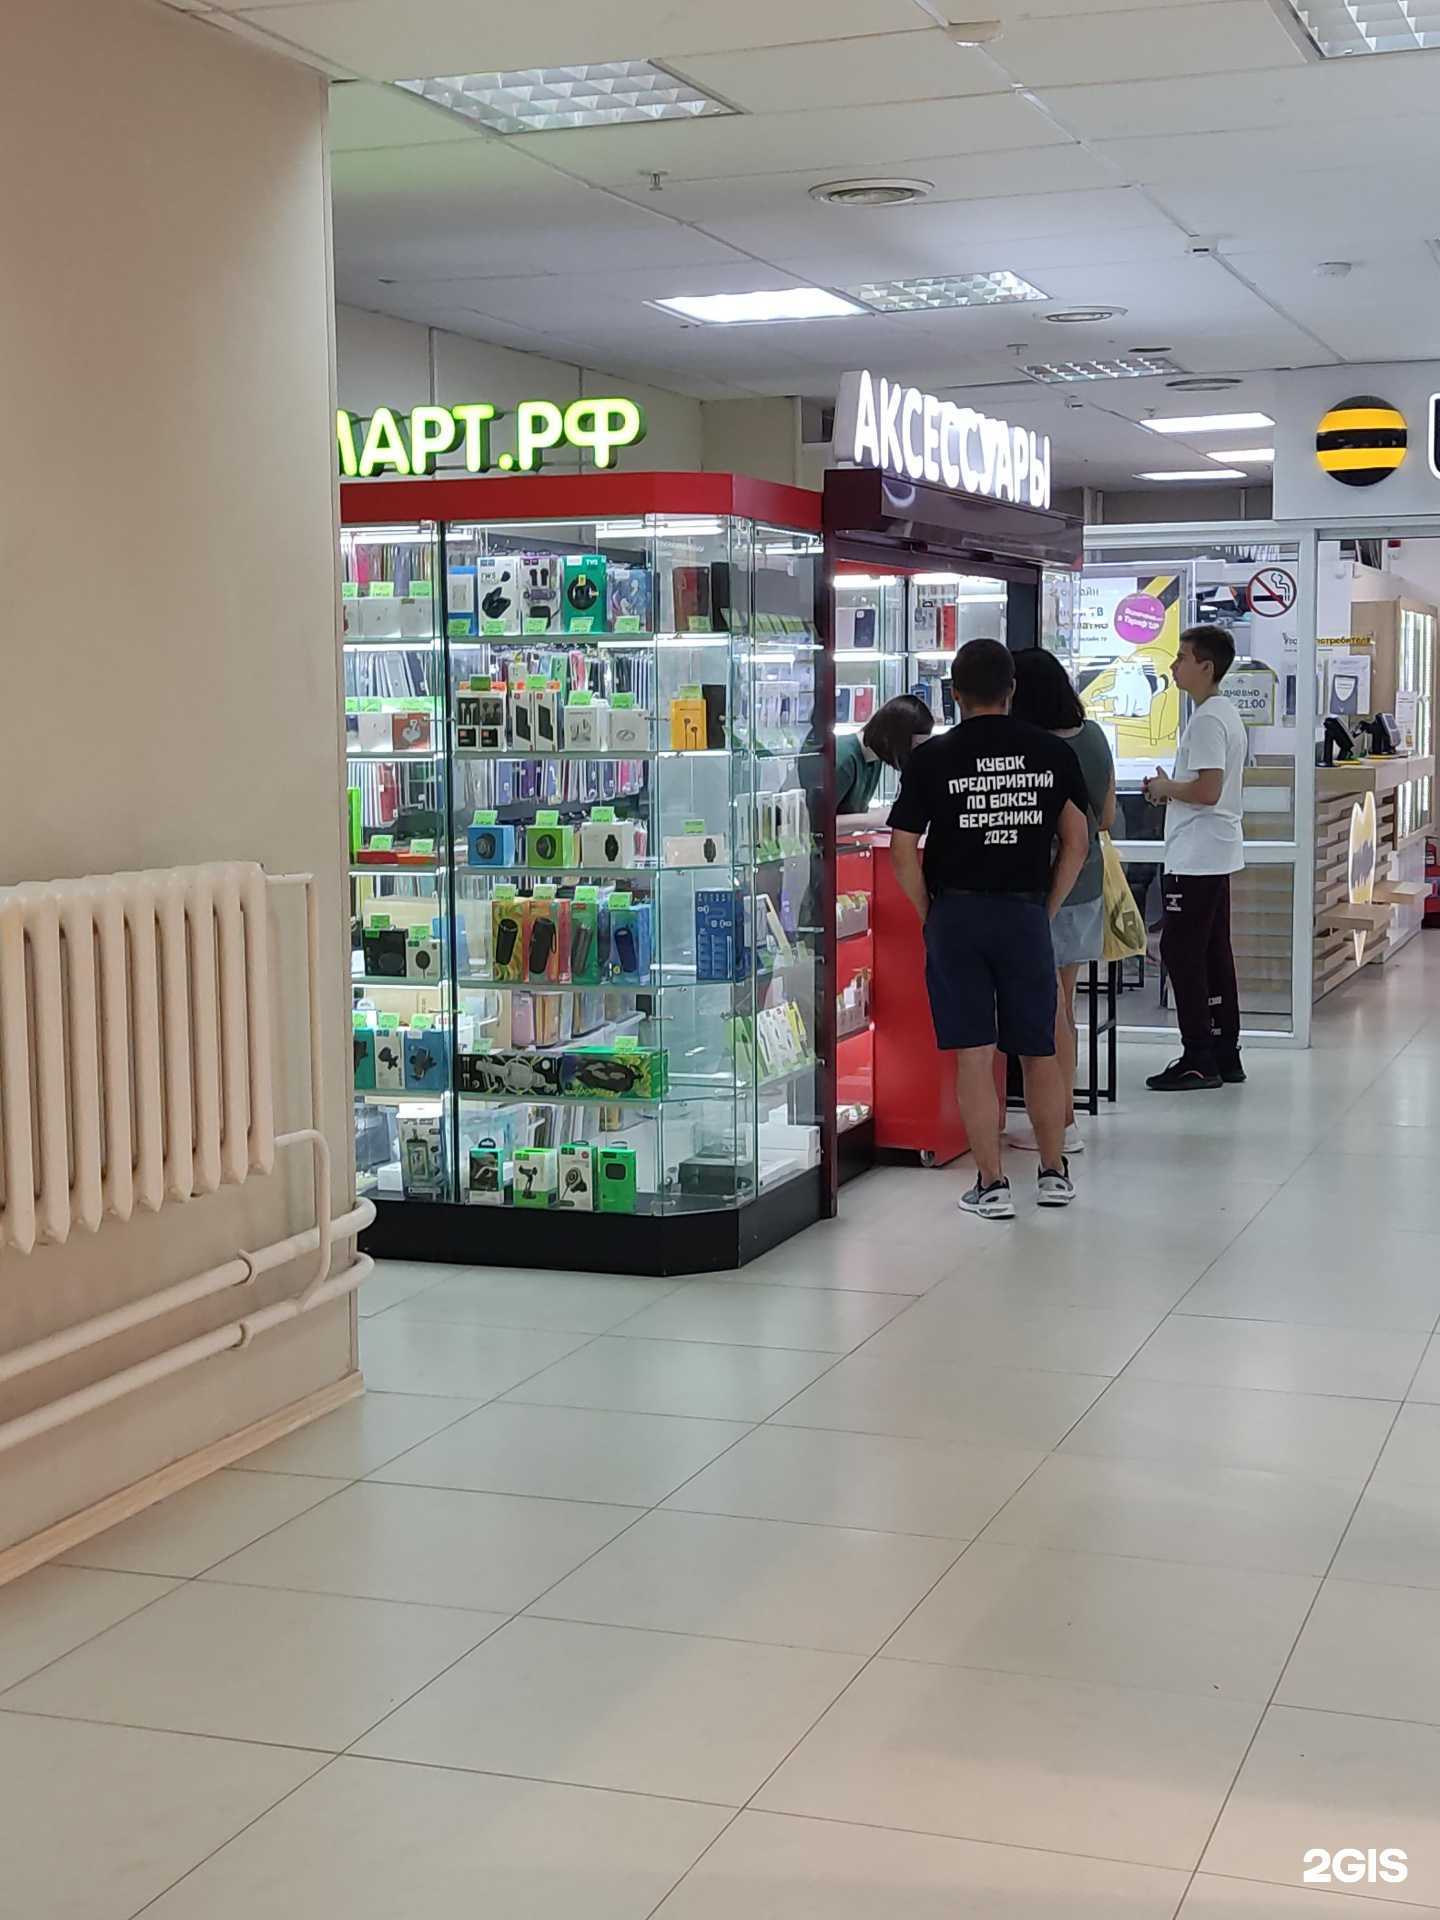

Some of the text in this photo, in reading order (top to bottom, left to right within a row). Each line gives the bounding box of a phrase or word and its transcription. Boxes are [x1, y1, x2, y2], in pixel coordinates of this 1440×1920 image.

[853, 369, 1051, 511] АКСЕССУАРЫ
[976, 755, 1026, 772] КУБОК
[948, 770, 1054, 795] ПРЕДПРИЯТИЙ
[966, 791, 1038, 809] ПО БОКСУ
[959, 810, 1042, 828] БЕРЕЗНИКИ
[984, 829, 1018, 845] 2023
